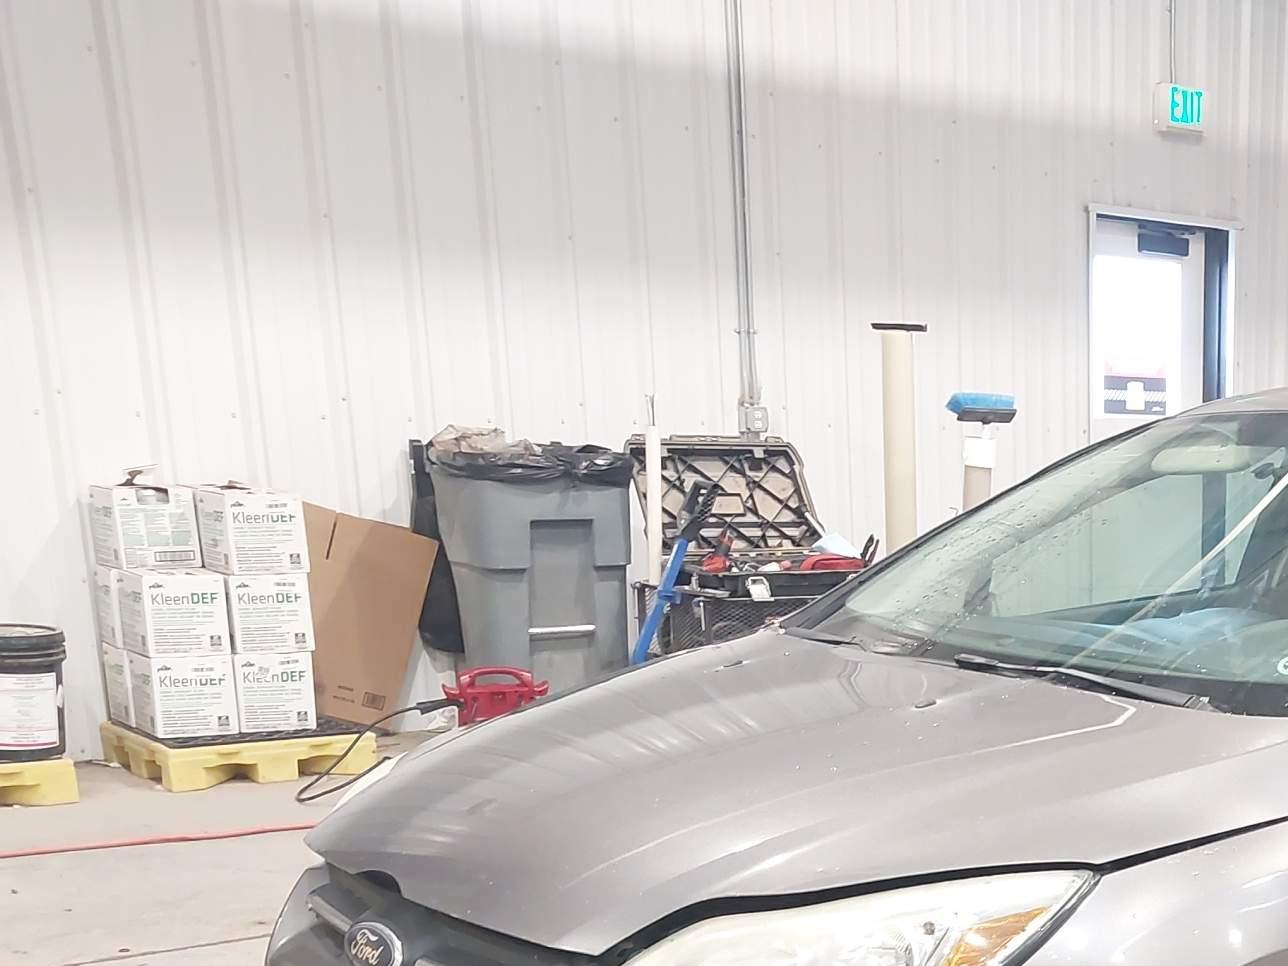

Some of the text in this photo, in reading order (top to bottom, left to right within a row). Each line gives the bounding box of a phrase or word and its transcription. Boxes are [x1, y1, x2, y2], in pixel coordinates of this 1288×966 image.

[1171, 86, 1203, 123] EXIT
[151, 592, 219, 606] KleenDEF
[237, 592, 302, 605] KleenDEF
[351, 929, 384, 966] Ford
